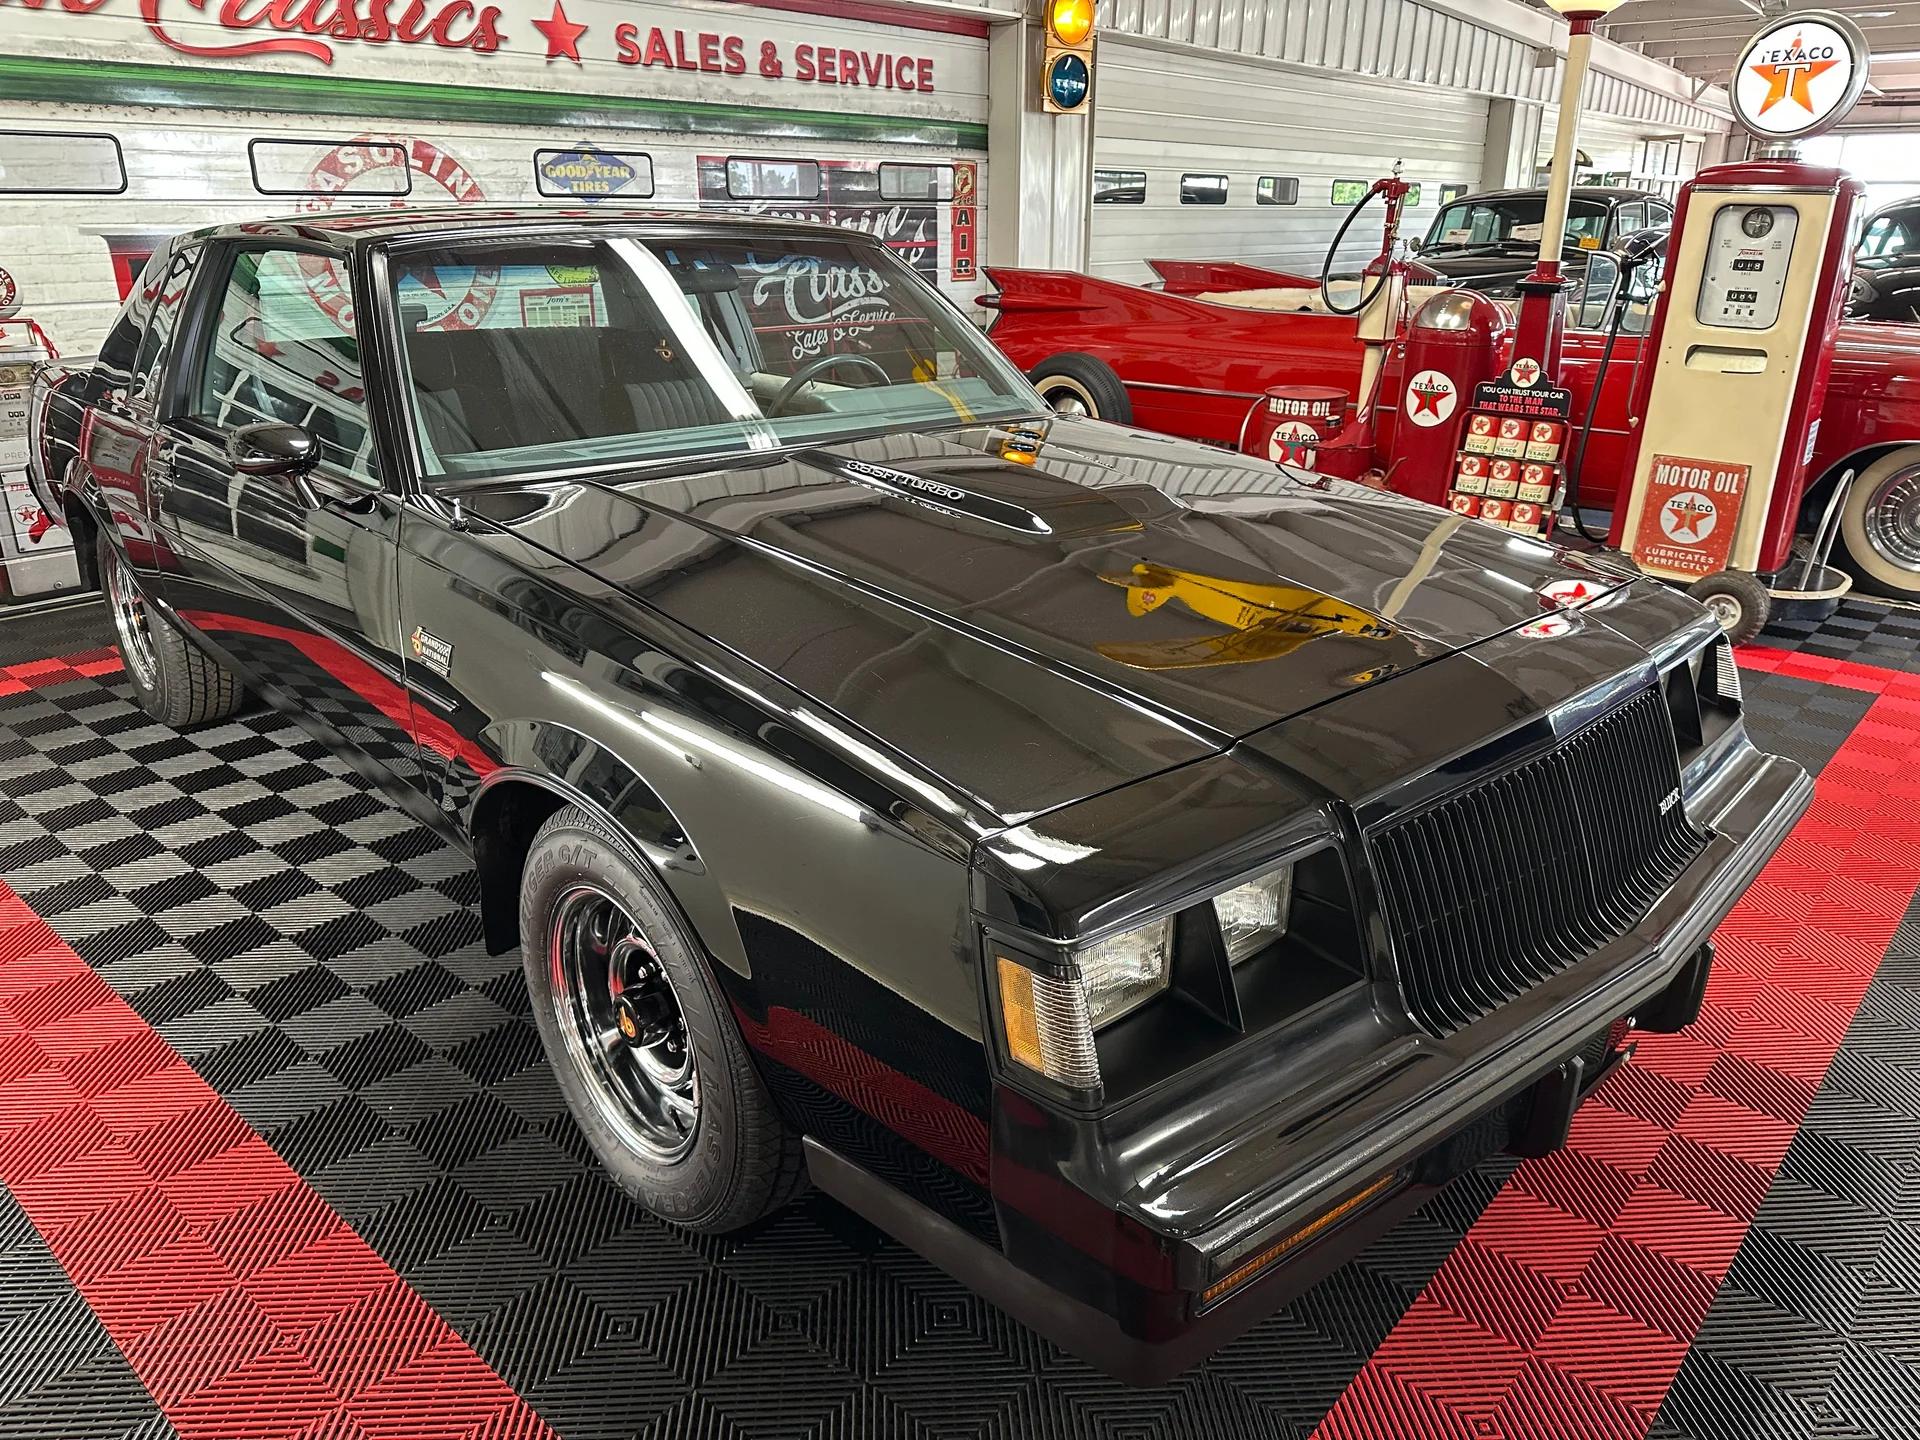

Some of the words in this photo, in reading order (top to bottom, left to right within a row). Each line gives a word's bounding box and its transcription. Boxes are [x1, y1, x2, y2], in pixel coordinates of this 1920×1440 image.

[615, 22, 746, 74] SALES
[759, 40, 783, 78] &
[795, 43, 935, 92] SERVICE
[570, 181, 609, 192] TIRES
[955, 208, 972, 275] AIR
[1414, 382, 1449, 391] TEXACO
[1512, 388, 1530, 396] TRUST
[1269, 397, 1309, 416] MOTOR
[1312, 402, 1331, 417] OIL
[1479, 401, 1497, 409] THAT
[1498, 402, 1523, 413] WEARS
[1525, 405, 1539, 414] THE
[1499, 394, 1508, 402] TO
[1509, 395, 1522, 404] THE
[1524, 397, 1543, 405] MAN
[1276, 431, 1317, 442] TEXACO
[1655, 464, 1711, 490] MOTOR
[1714, 472, 1739, 494] OIL
[1670, 500, 1713, 513] TEXACO
[1645, 547, 1714, 564] LUBRICATES
[1646, 556, 1710, 572] PERFECTLY
[1658, 787, 1680, 816] BUICK
[558, 844, 598, 869] G/T
